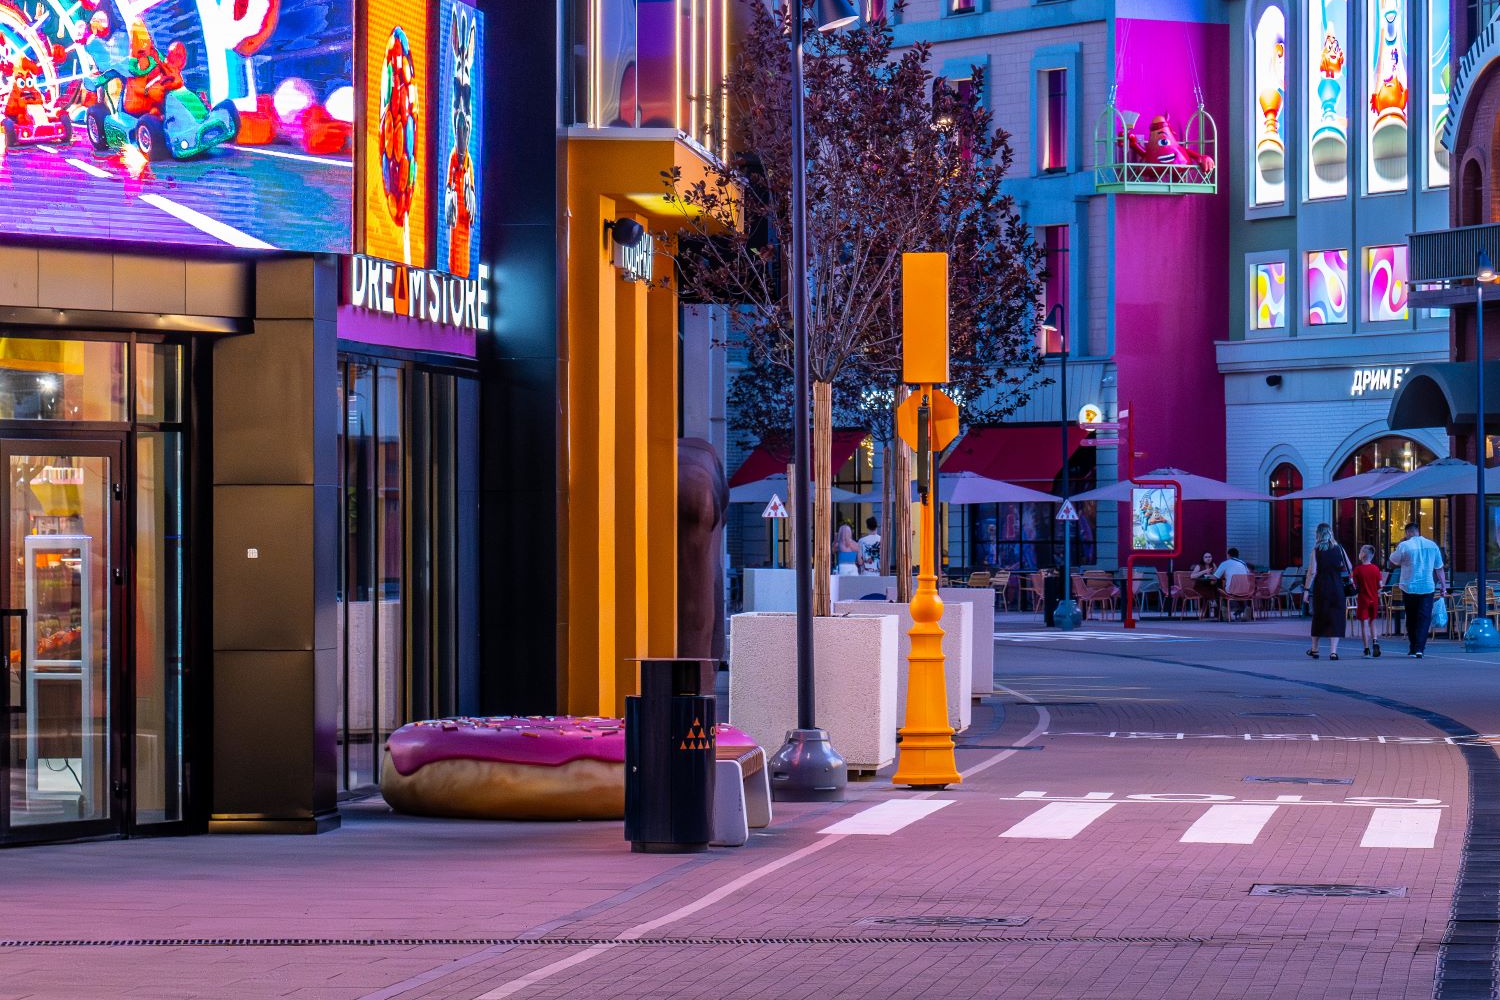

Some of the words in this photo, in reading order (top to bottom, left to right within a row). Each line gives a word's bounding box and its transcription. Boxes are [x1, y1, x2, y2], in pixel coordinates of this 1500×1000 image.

[428, 263, 489, 331] STORE
[1350, 368, 1392, 396] ДРИМ
[1393, 367, 1410, 389] Б
